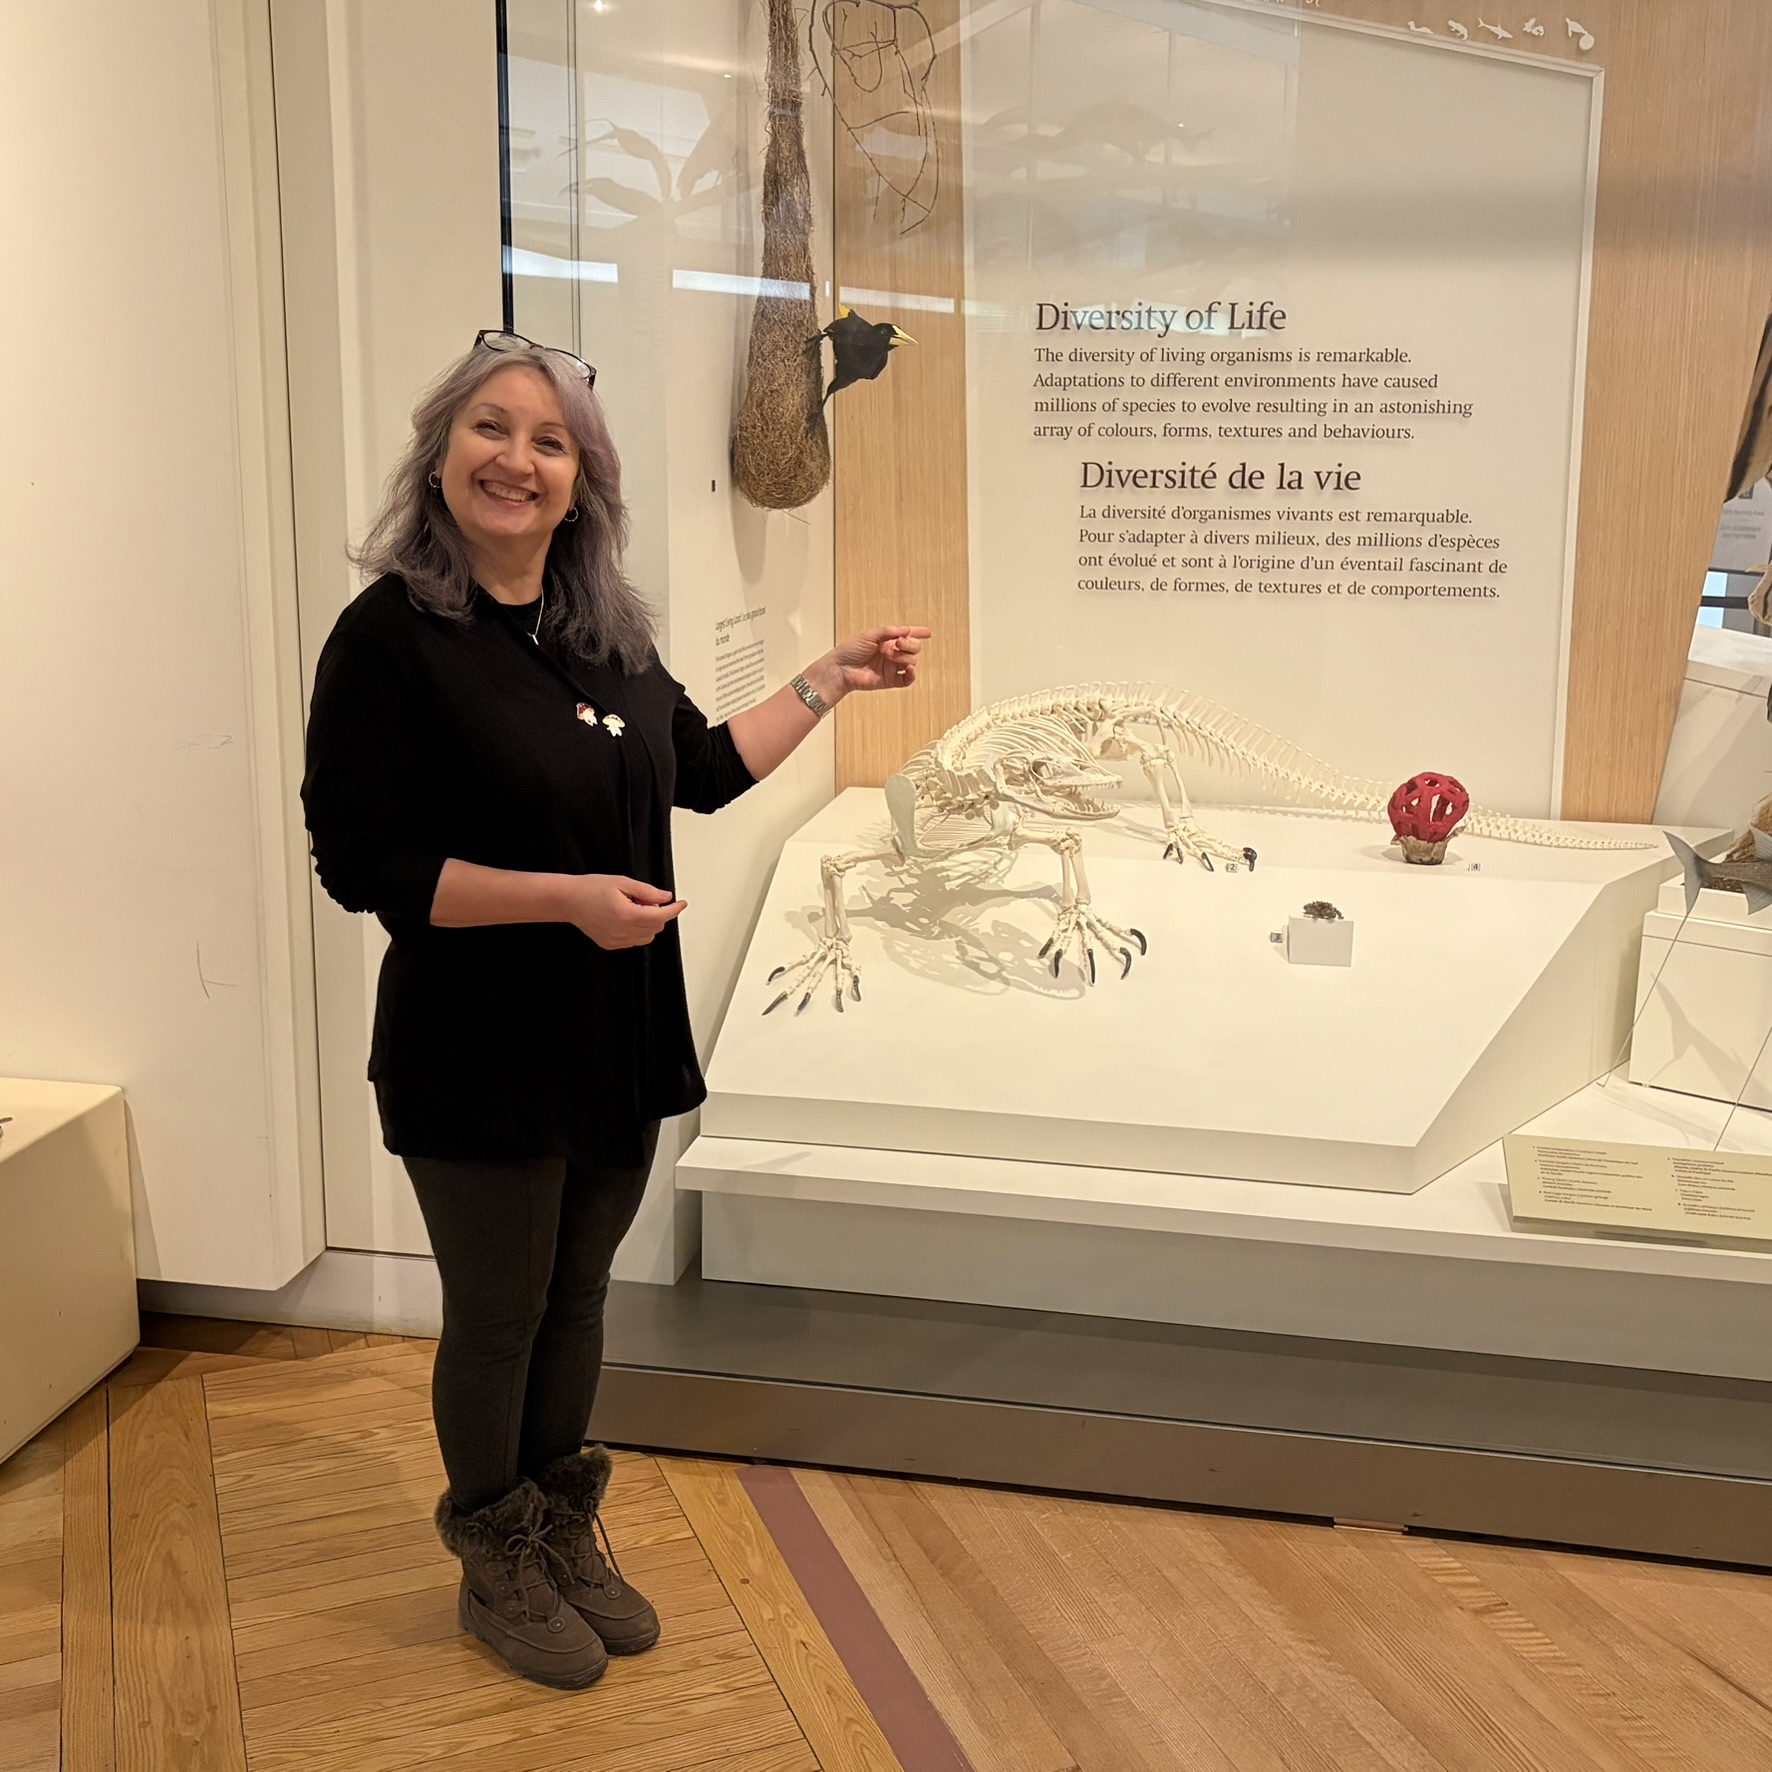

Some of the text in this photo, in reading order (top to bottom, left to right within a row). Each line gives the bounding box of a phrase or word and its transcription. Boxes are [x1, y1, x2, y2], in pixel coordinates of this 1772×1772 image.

[1036, 302, 1287, 338] Diversity of Life
[1033, 347, 1412, 367] The diversity of living organisms is remarkable.
[1032, 372, 1438, 392] Adaptations to different environments have caused
[1034, 397, 1474, 419] millions of species to evolve resulting in an astonishing
[1033, 422, 1415, 441] array of colours, forms, textures and behaviours.
[1079, 460, 1362, 491] Diversité de la vie
[1079, 504, 1472, 527] La diversité d'organismes vivants est remarquable.
[1079, 528, 1500, 553] Pour s'adapter à divers milieux, des millions d'espèces
[1078, 552, 1508, 574] ont évolué et sont à l'origine d'un éventail fascinant de
[1077, 576, 1500, 600] couleurs, de formes, de textures et de comportements.
